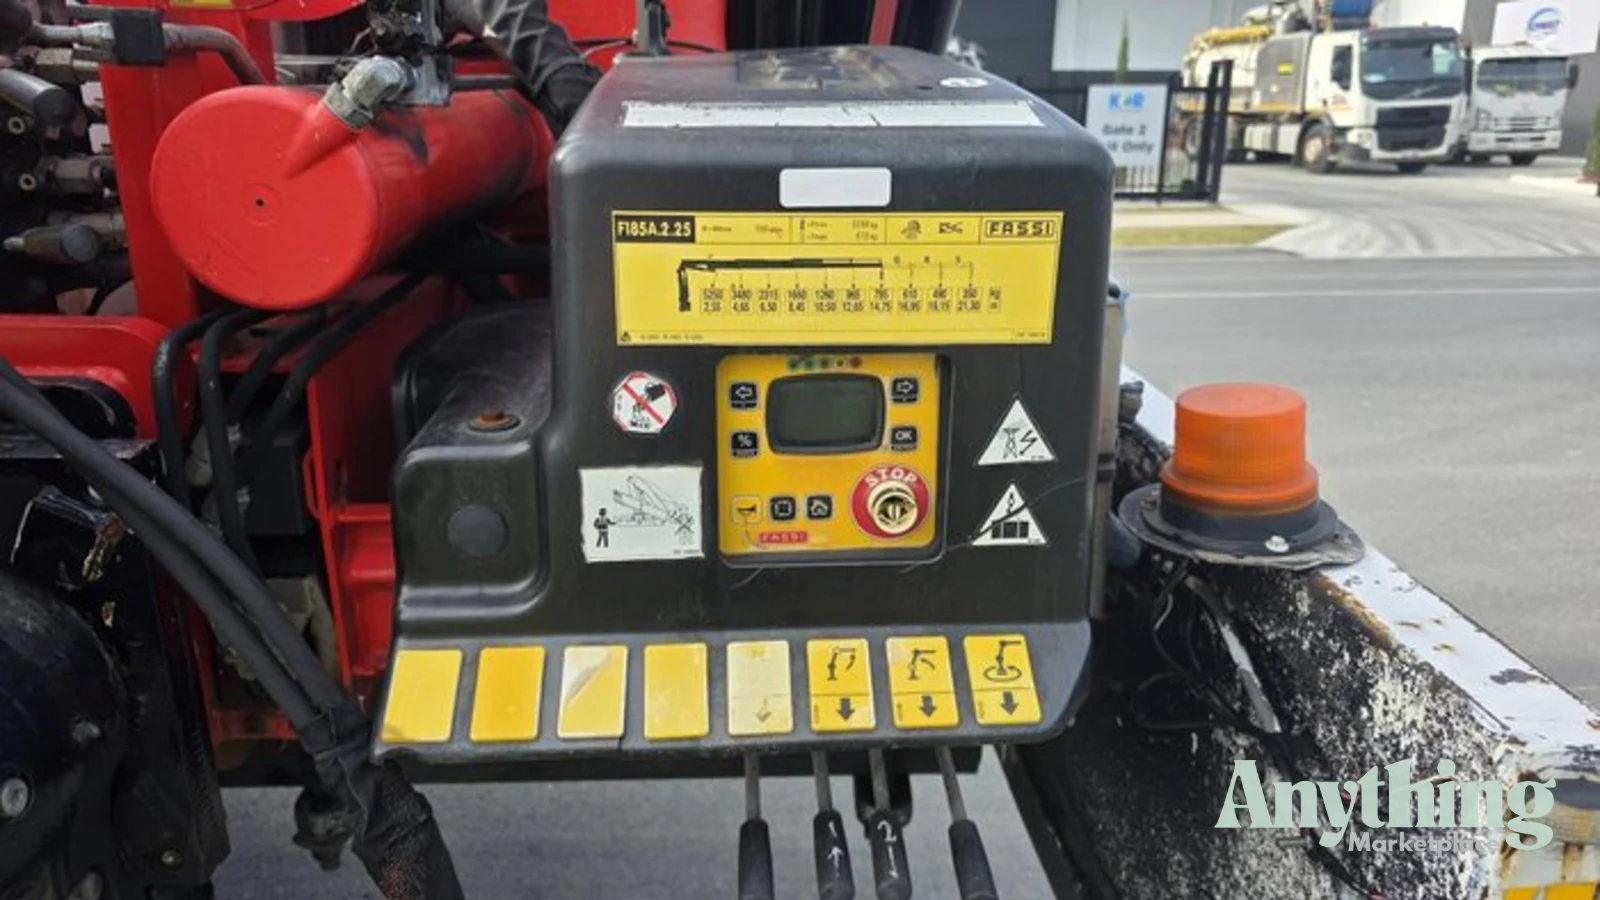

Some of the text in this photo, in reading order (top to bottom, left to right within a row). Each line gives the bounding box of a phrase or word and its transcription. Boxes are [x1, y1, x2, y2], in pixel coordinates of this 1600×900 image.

[1102, 124, 1147, 135] Gate 2
[1122, 140, 1154, 154] Only
[617, 221, 692, 237] F185A.2.25
[989, 220, 1052, 236] FASSI
[895, 430, 913, 440] OK
[864, 467, 918, 487] STOP
[877, 820, 897, 842] 2
